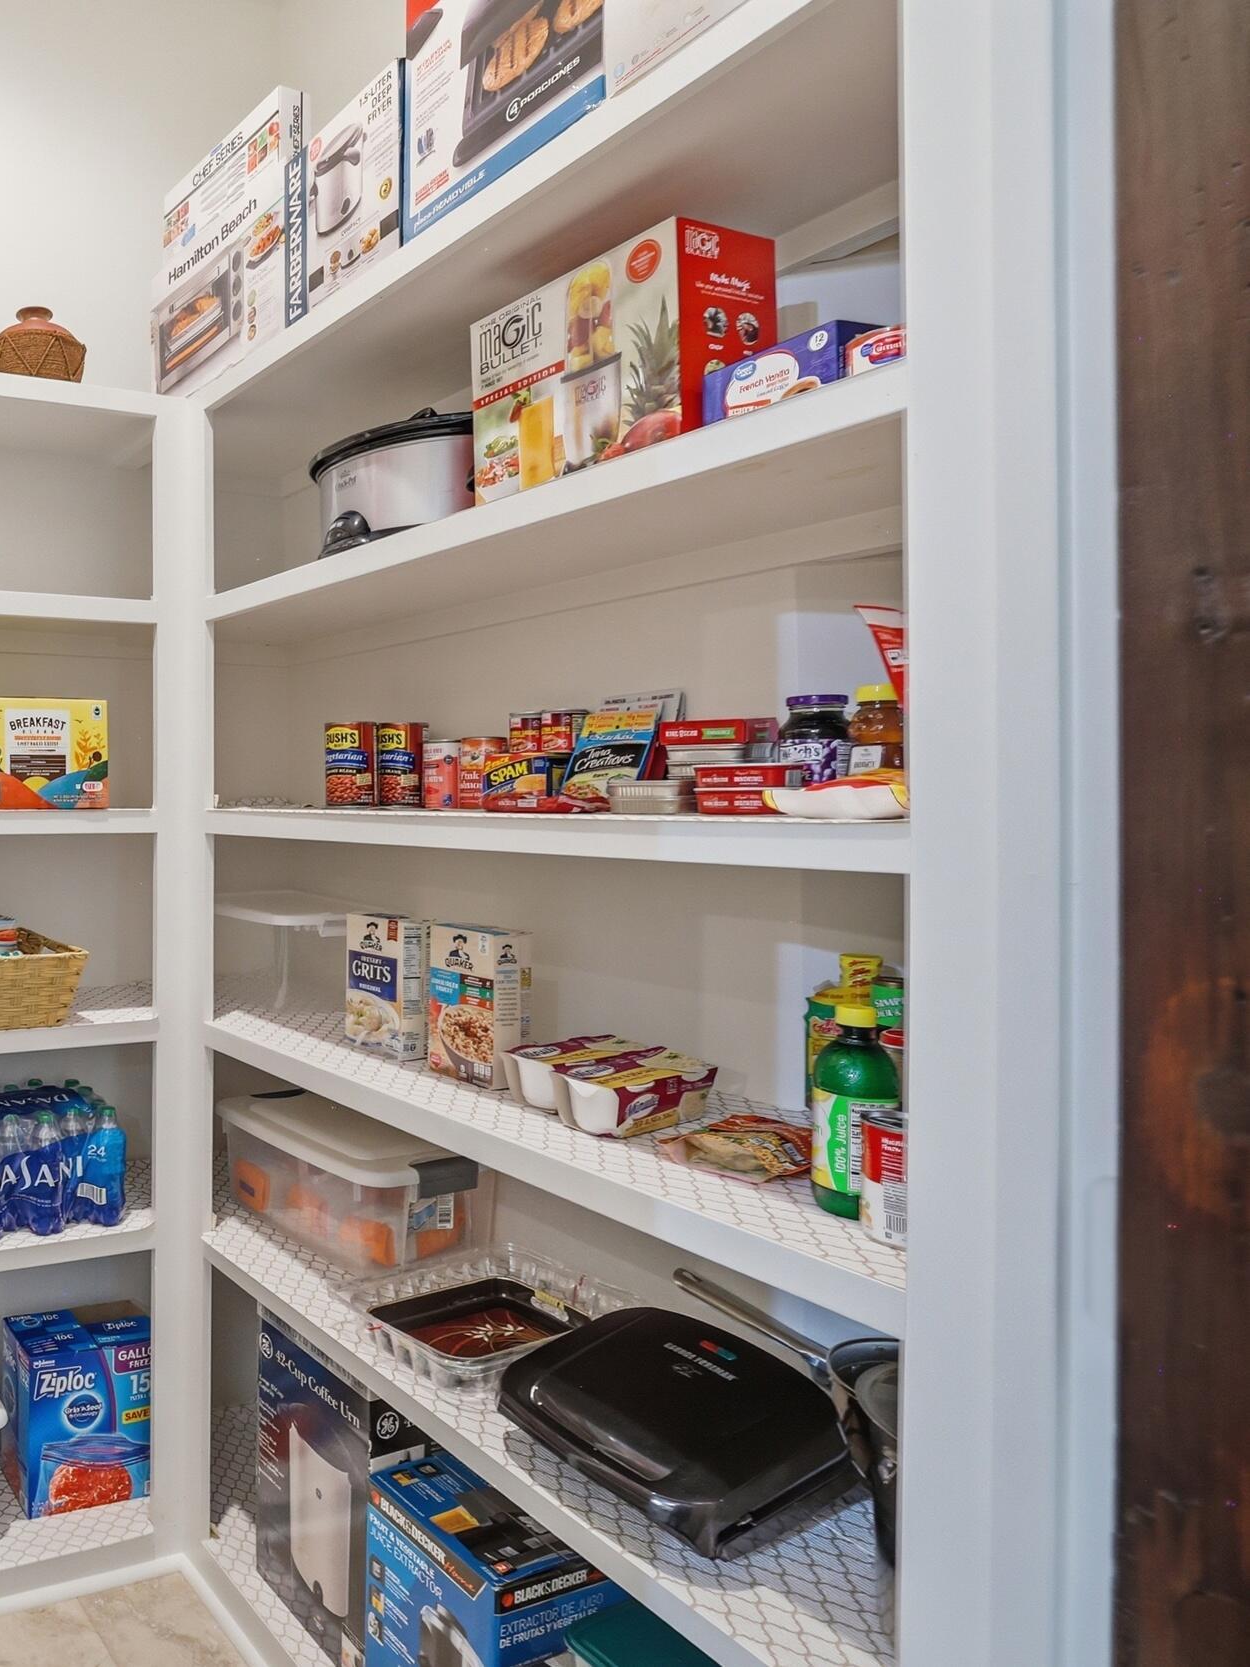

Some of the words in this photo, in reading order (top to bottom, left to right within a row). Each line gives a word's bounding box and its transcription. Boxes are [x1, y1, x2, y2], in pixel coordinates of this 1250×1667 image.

[520, 56, 581, 109] PORCIONES
[371, 84, 392, 108] DEEP
[367, 96, 392, 125] FRYER
[192, 159, 215, 187] CHEF
[216, 131, 244, 167] SERIES
[168, 236, 220, 285] Hamilton
[221, 199, 257, 242] Beach
[289, 157, 301, 320] FARBERWARE
[499, 296, 541, 320] ORIGINAL
[480, 334, 542, 375] BULLET
[480, 386, 513, 406] SPECIAL
[518, 366, 556, 389] EDITION
[739, 378, 763, 393] French
[9, 716, 67, 732] BREAKFAST
[574, 753, 636, 772] Creations
[586, 747, 612, 761] Tuna
[490, 761, 529, 786] SPAM
[352, 960, 392, 983] GRITS
[445, 957, 474, 972] QUAKER
[835, 1114, 847, 1145] Juice
[87, 1145, 106, 1157] 24
[835, 1148, 846, 1173] 100%
[106, 1321, 137, 1332] Ziploc
[39, 1372, 95, 1399] Ziploc
[275, 1349, 307, 1389] 42-Cup
[307, 1377, 339, 1411] Coffee
[340, 1402, 361, 1430] Urn
[125, 1409, 150, 1422] SAVE
[369, 1526, 393, 1555] JUICE
[393, 1547, 443, 1600] EXTRACTOR
[397, 1536, 436, 1580] VEGETABLE
[500, 1608, 559, 1638] EXTRACTOR
[561, 1601, 575, 1618] DE
[576, 1592, 605, 1614] JUGO
[499, 1637, 512, 1649] DE
[513, 1626, 546, 1645] FRUTAS
